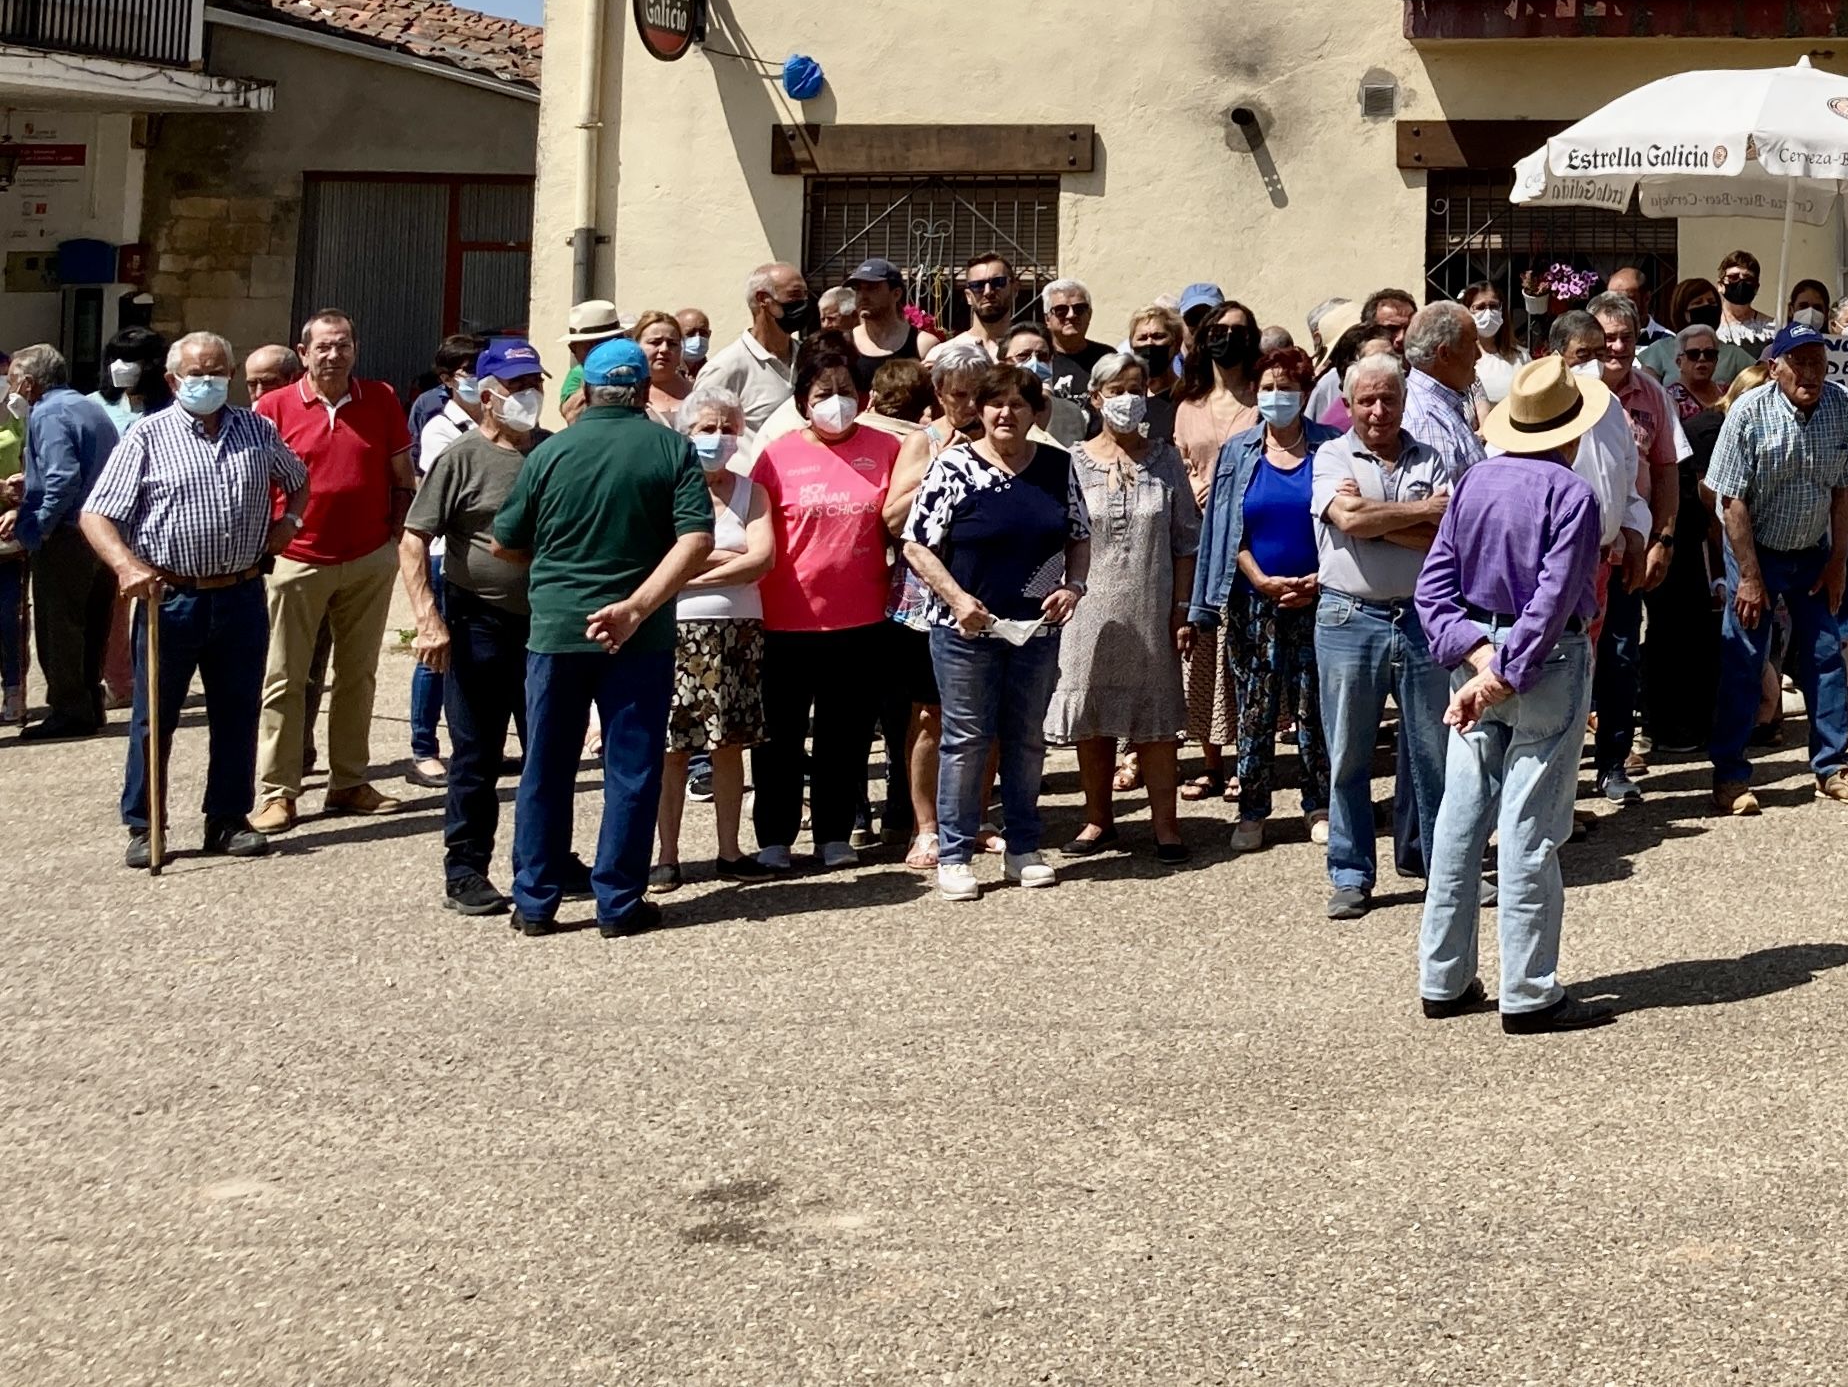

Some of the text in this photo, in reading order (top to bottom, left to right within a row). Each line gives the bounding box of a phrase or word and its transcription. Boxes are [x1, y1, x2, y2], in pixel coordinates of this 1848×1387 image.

[1566, 144, 1709, 171] Estrella Galicia
[800, 491, 850, 508] GANAN
[826, 500, 879, 517] CHICAS
